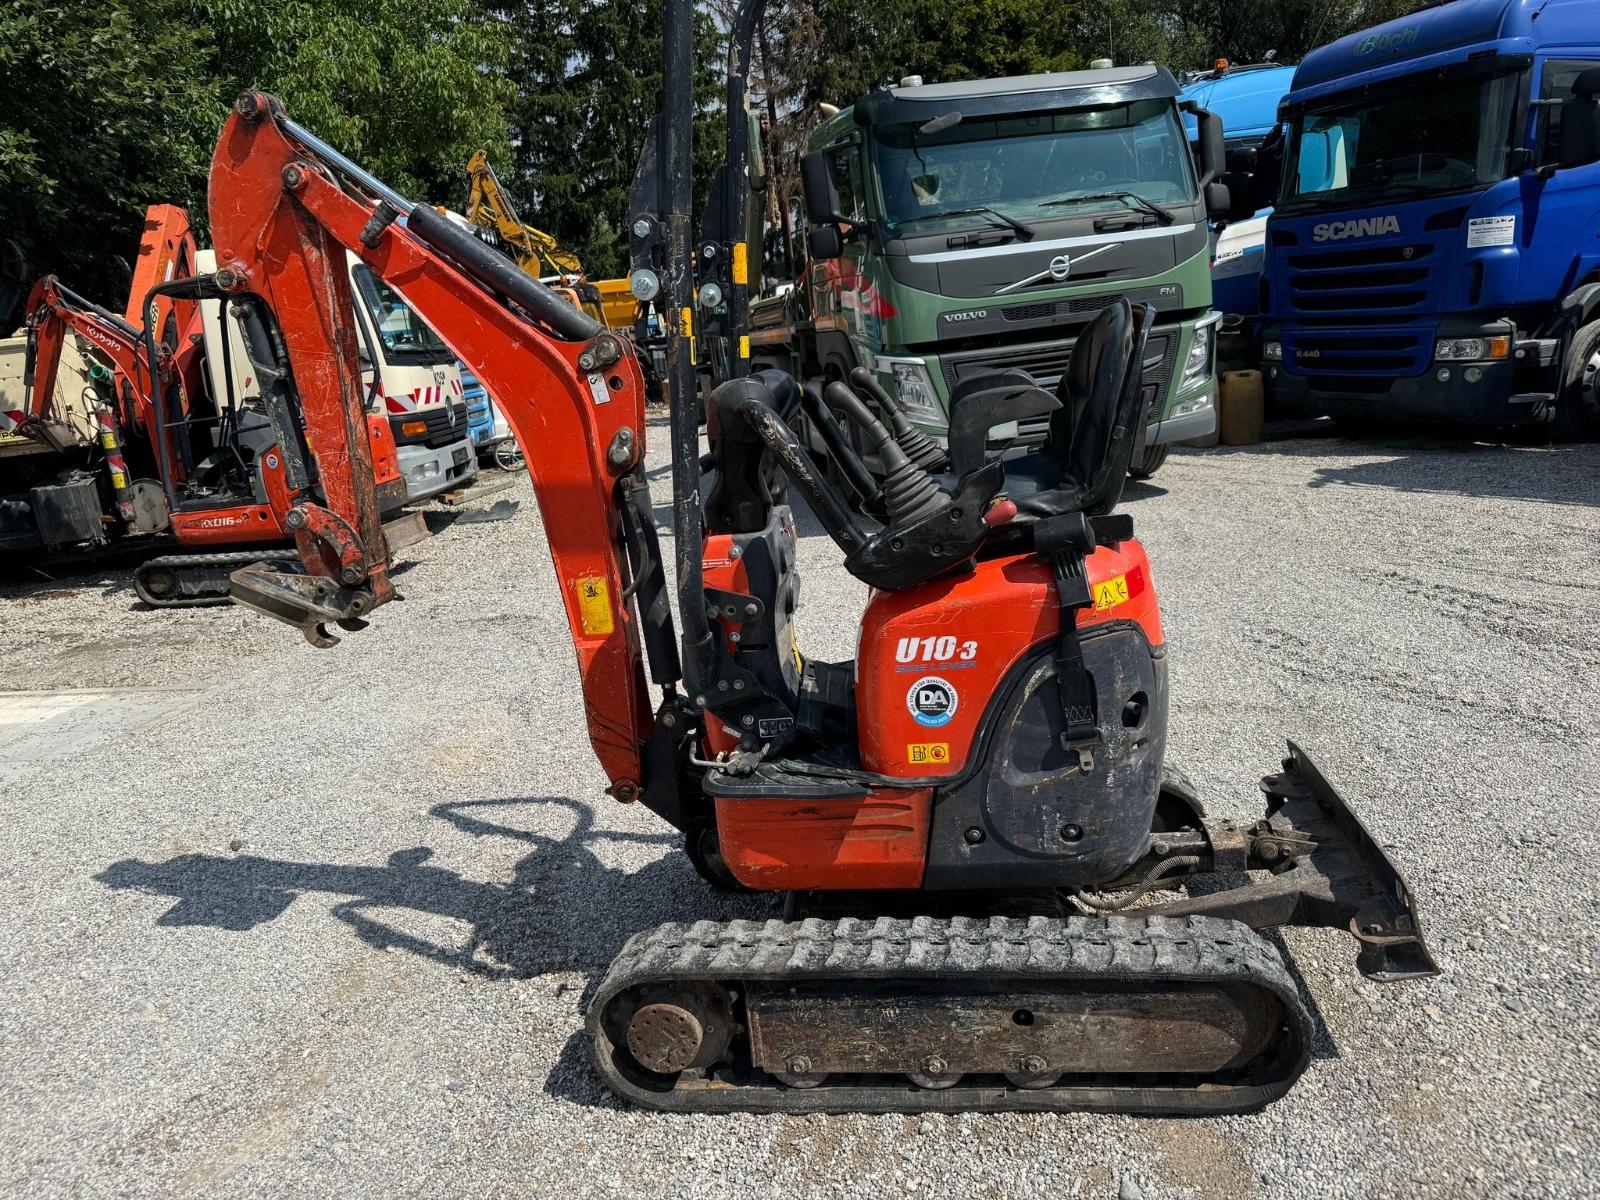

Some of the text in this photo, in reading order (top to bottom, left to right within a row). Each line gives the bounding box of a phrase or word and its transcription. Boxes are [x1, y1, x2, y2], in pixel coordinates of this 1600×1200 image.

[1313, 215, 1400, 242] SCANIA
[1160, 286, 1176, 296] FM
[943, 310, 988, 322] VOLVO
[86, 325, 121, 352] Kubota
[929, 661, 977, 671] LEVER
[920, 690, 949, 705] DA
